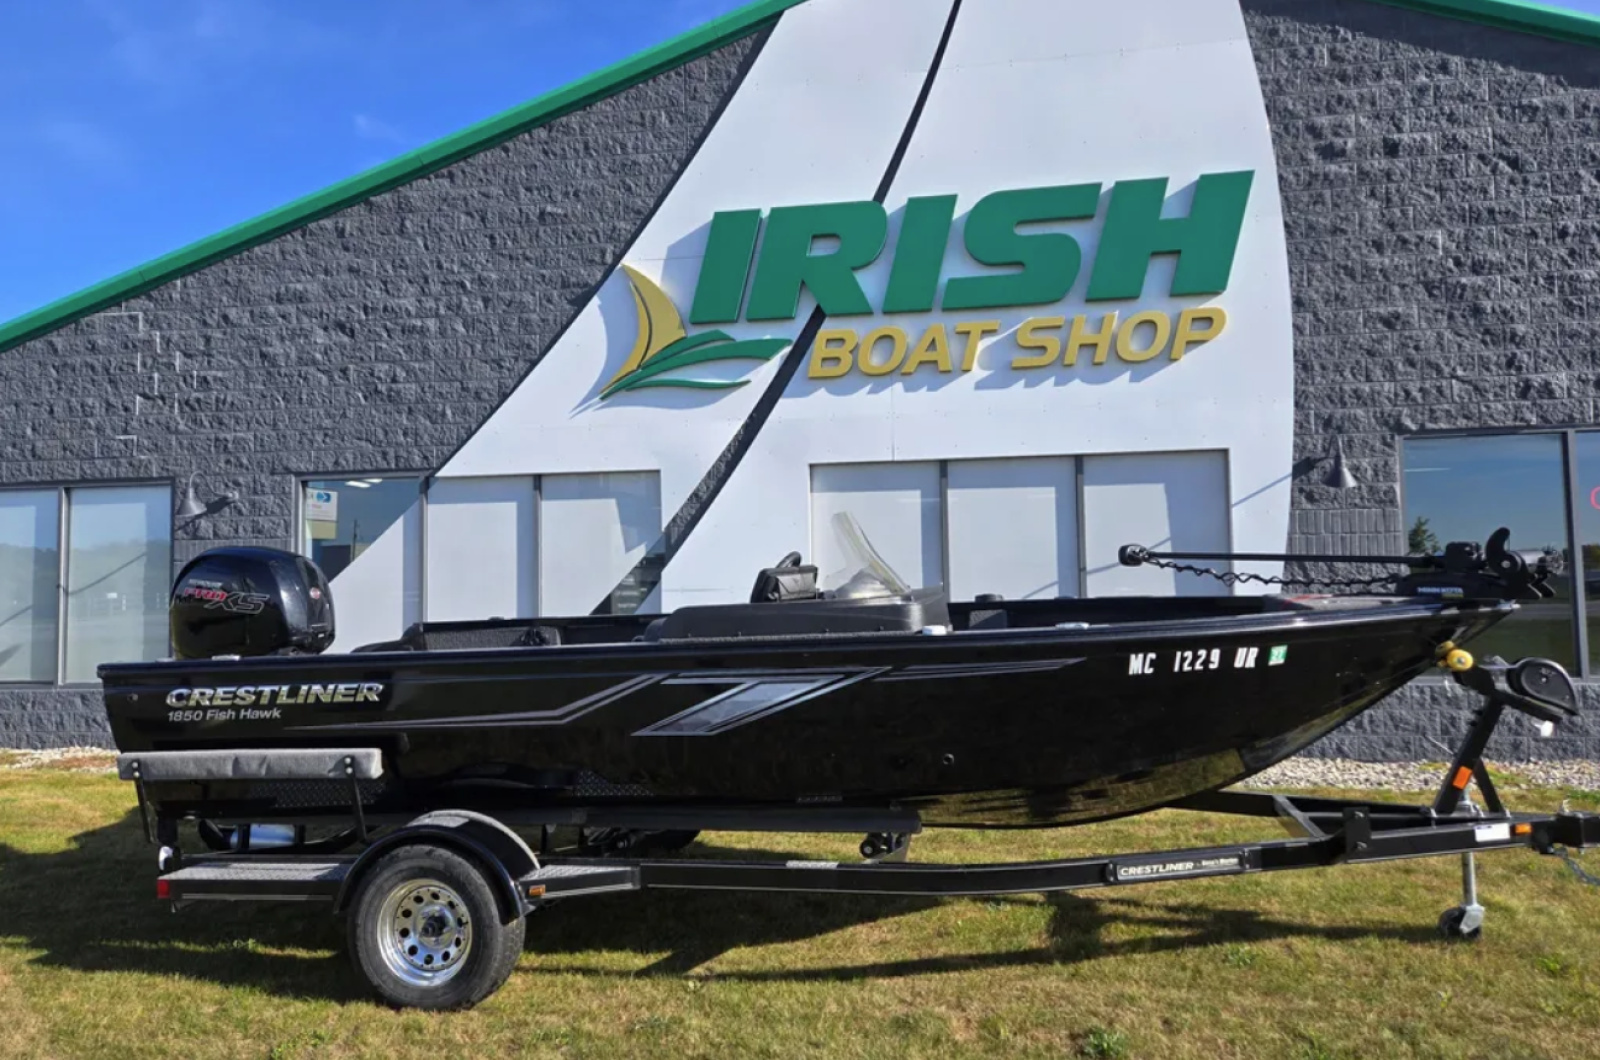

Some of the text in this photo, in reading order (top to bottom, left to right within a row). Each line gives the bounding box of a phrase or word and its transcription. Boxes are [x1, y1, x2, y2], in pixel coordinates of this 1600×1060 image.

[690, 169, 1255, 324] IRISH
[808, 307, 1227, 379] BOAT SHOP
[184, 587, 270, 615] PRO XS
[1128, 652, 1156, 675] MC
[1173, 648, 1220, 672] 1229
[166, 683, 384, 708] CRESTLINER
[167, 707, 281, 722] 1850 Fish Hawk
[1121, 862, 1194, 876] CRESTLINER
